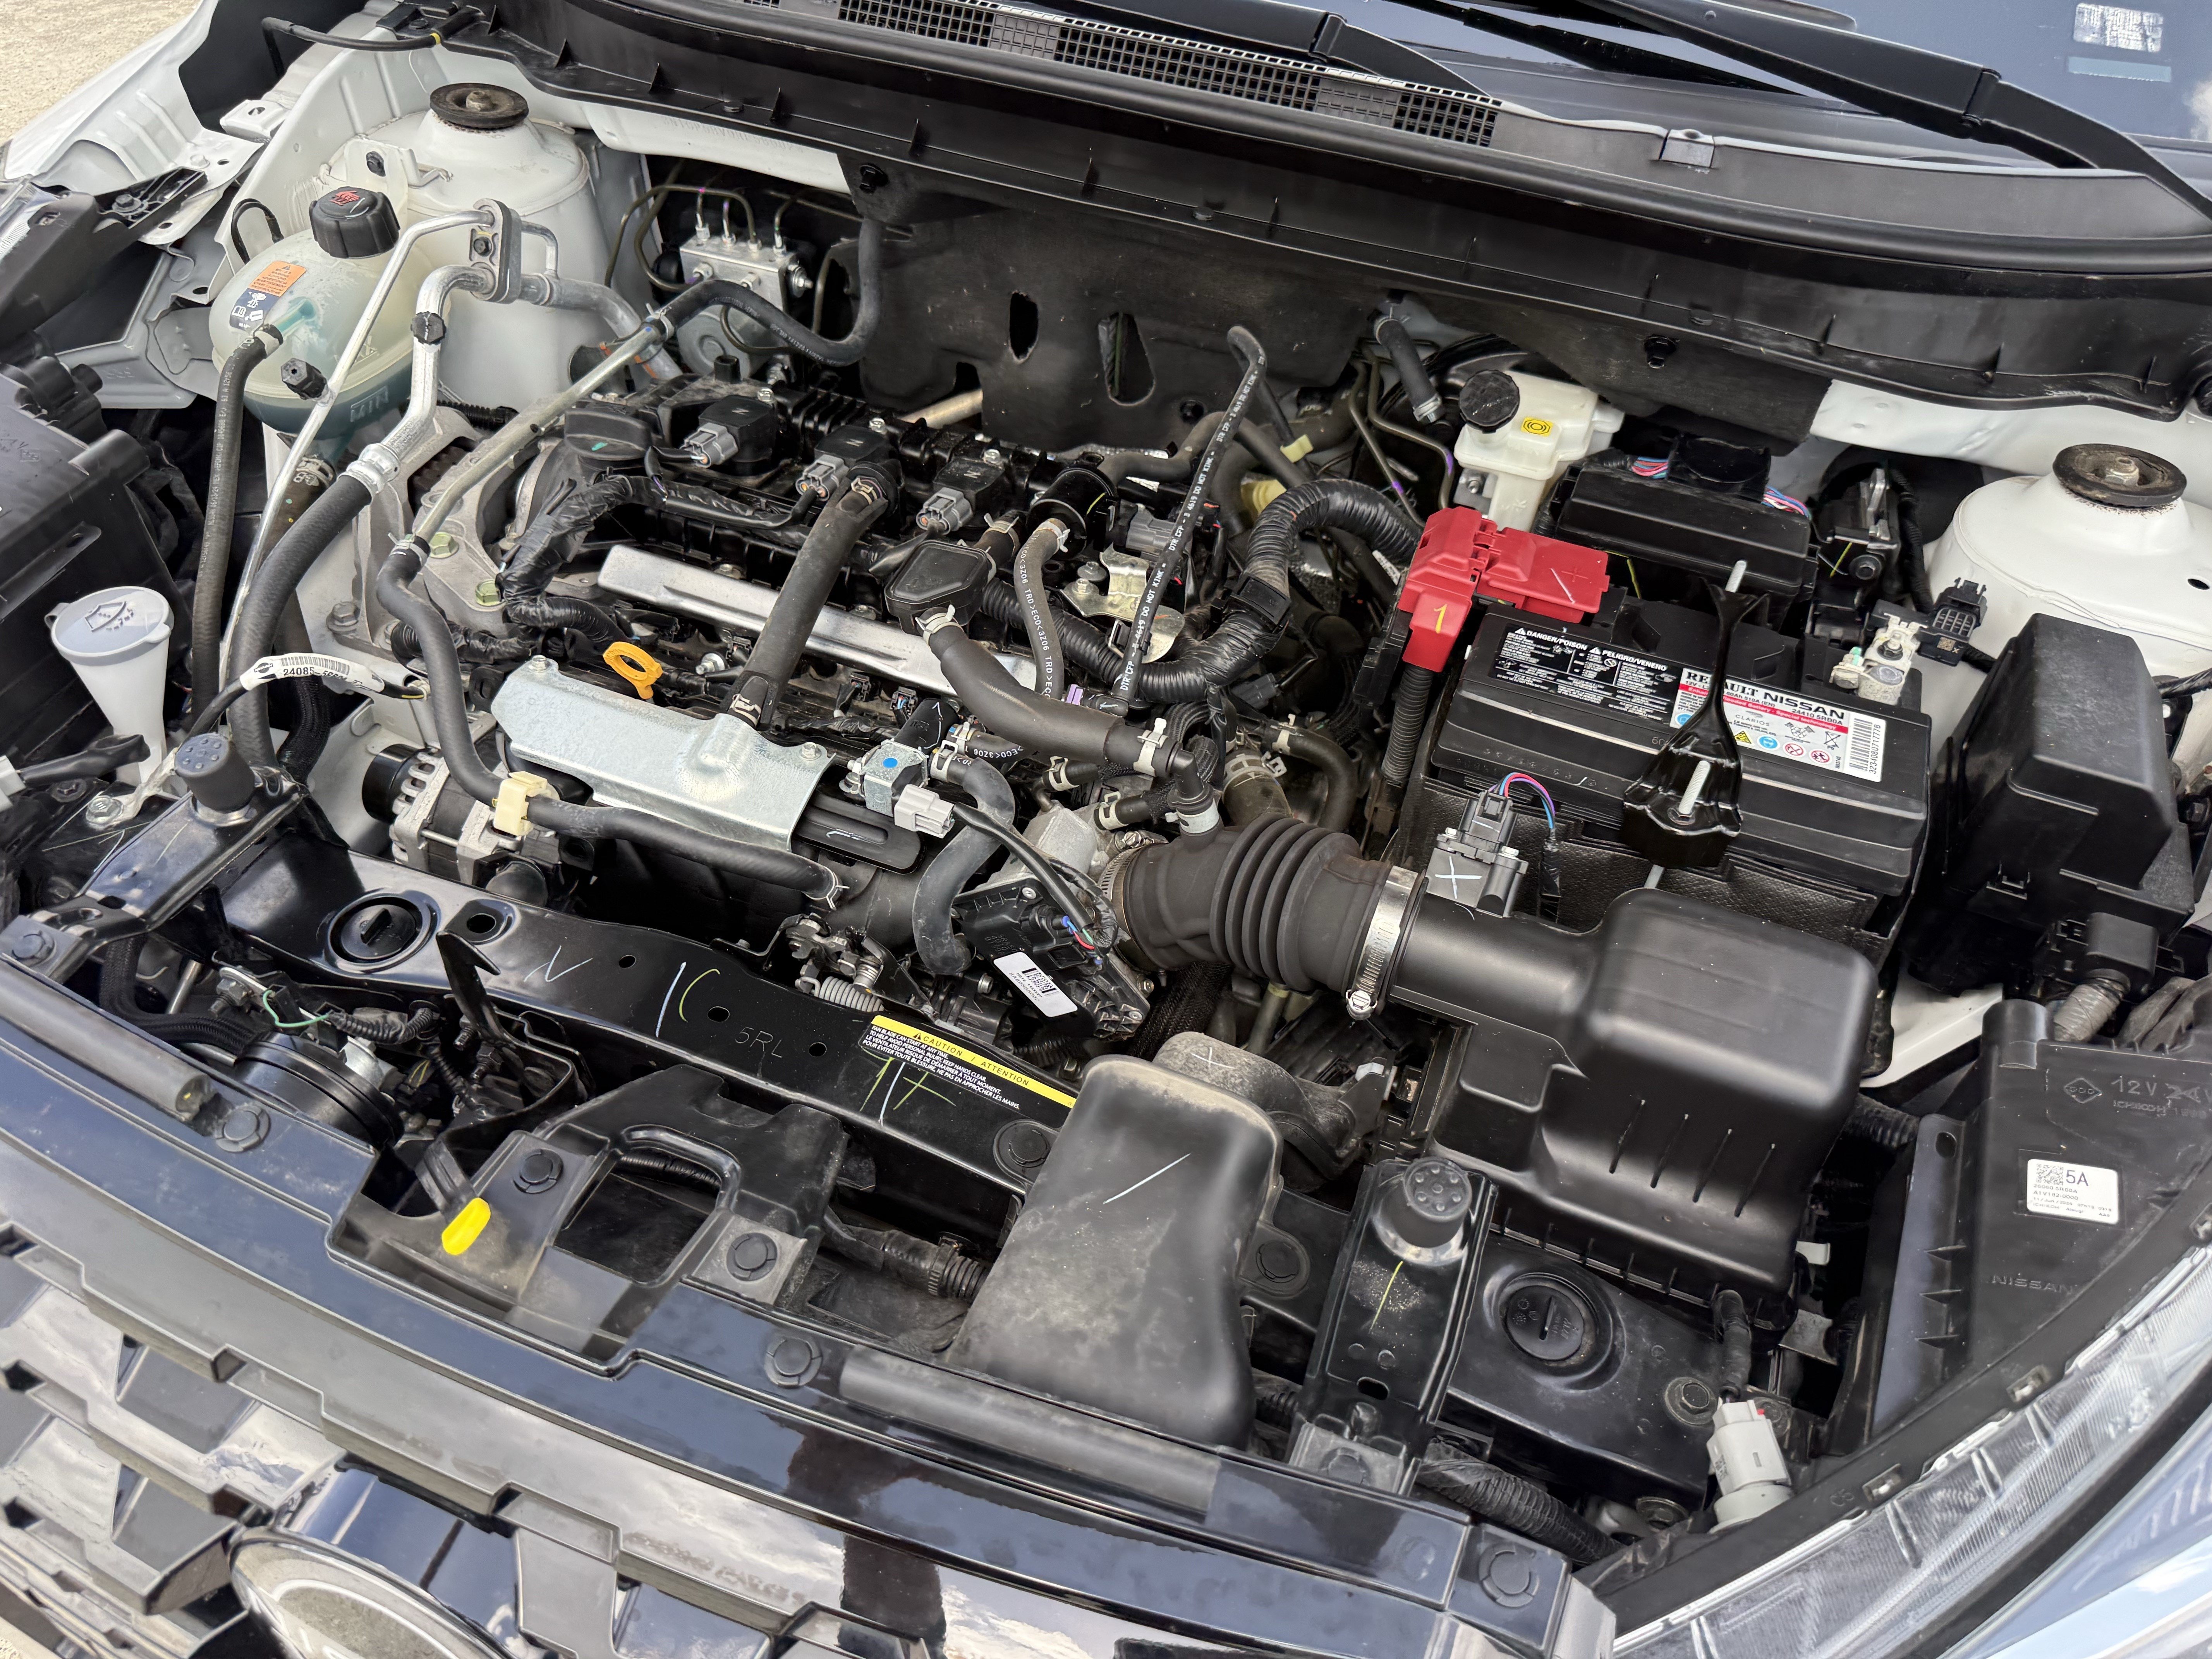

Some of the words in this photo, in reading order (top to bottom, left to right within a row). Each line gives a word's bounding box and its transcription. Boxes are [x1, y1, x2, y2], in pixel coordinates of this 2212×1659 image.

[1202, 457, 1214, 472] KINK
[1197, 473, 1207, 485] NOT
[1193, 486, 1202, 495] DO
[1187, 496, 1197, 510] 4619
[1175, 526, 1184, 538] CFP
[1168, 538, 1178, 551] DTR
[1120, 675, 1131, 690] DTR
[1126, 661, 1134, 675] CFP
[1142, 606, 1150, 617] DO
[1146, 589, 1155, 604] NOT
[1152, 570, 1164, 587] KINK
[1527, 630, 1588, 651] DANGER/POISON
[1602, 650, 1667, 672] PELIGRO/VENENO
[1686, 672, 1758, 696] REULT
[1764, 692, 1844, 720] NISSAN
[1735, 714, 1770, 727] CLARIOS
[1792, 709, 1814, 718] 24410
[1817, 714, 1843, 726] 5RB0A
[882, 1029, 896, 1038] BLADE
[907, 1037, 919, 1047] START
[872, 1037, 905, 1053] VENTILATEUR
[904, 1049, 923, 1060] RISQUE
[964, 1075, 977, 1084] TOUT
[977, 1080, 1001, 1095] MOMENT.
[876, 1033, 888, 1041] HELP
[888, 1037, 903, 1046] AVOID
[902, 1042, 926, 1056] PERSONAL
[943, 1057, 955, 1067] KEEP
[954, 1063, 971, 1075] HANDS
[971, 1072, 986, 1082] CLEAR.
[923, 1036, 963, 1056] CAUTION
[981, 1061, 1029, 1086] ATTENTION
[862, 1039, 877, 1049] POUR
[895, 1051, 910, 1061] TOUTE
[945, 1072, 954, 1080] PAS
[954, 1077, 963, 1085] EN
[962, 1081, 992, 1097] APPROCHER
[1002, 1097, 1020, 1110] MAINS.
[2066, 1170, 2089, 1187] 5A
[1992, 1275, 2073, 1294] NISSAN
